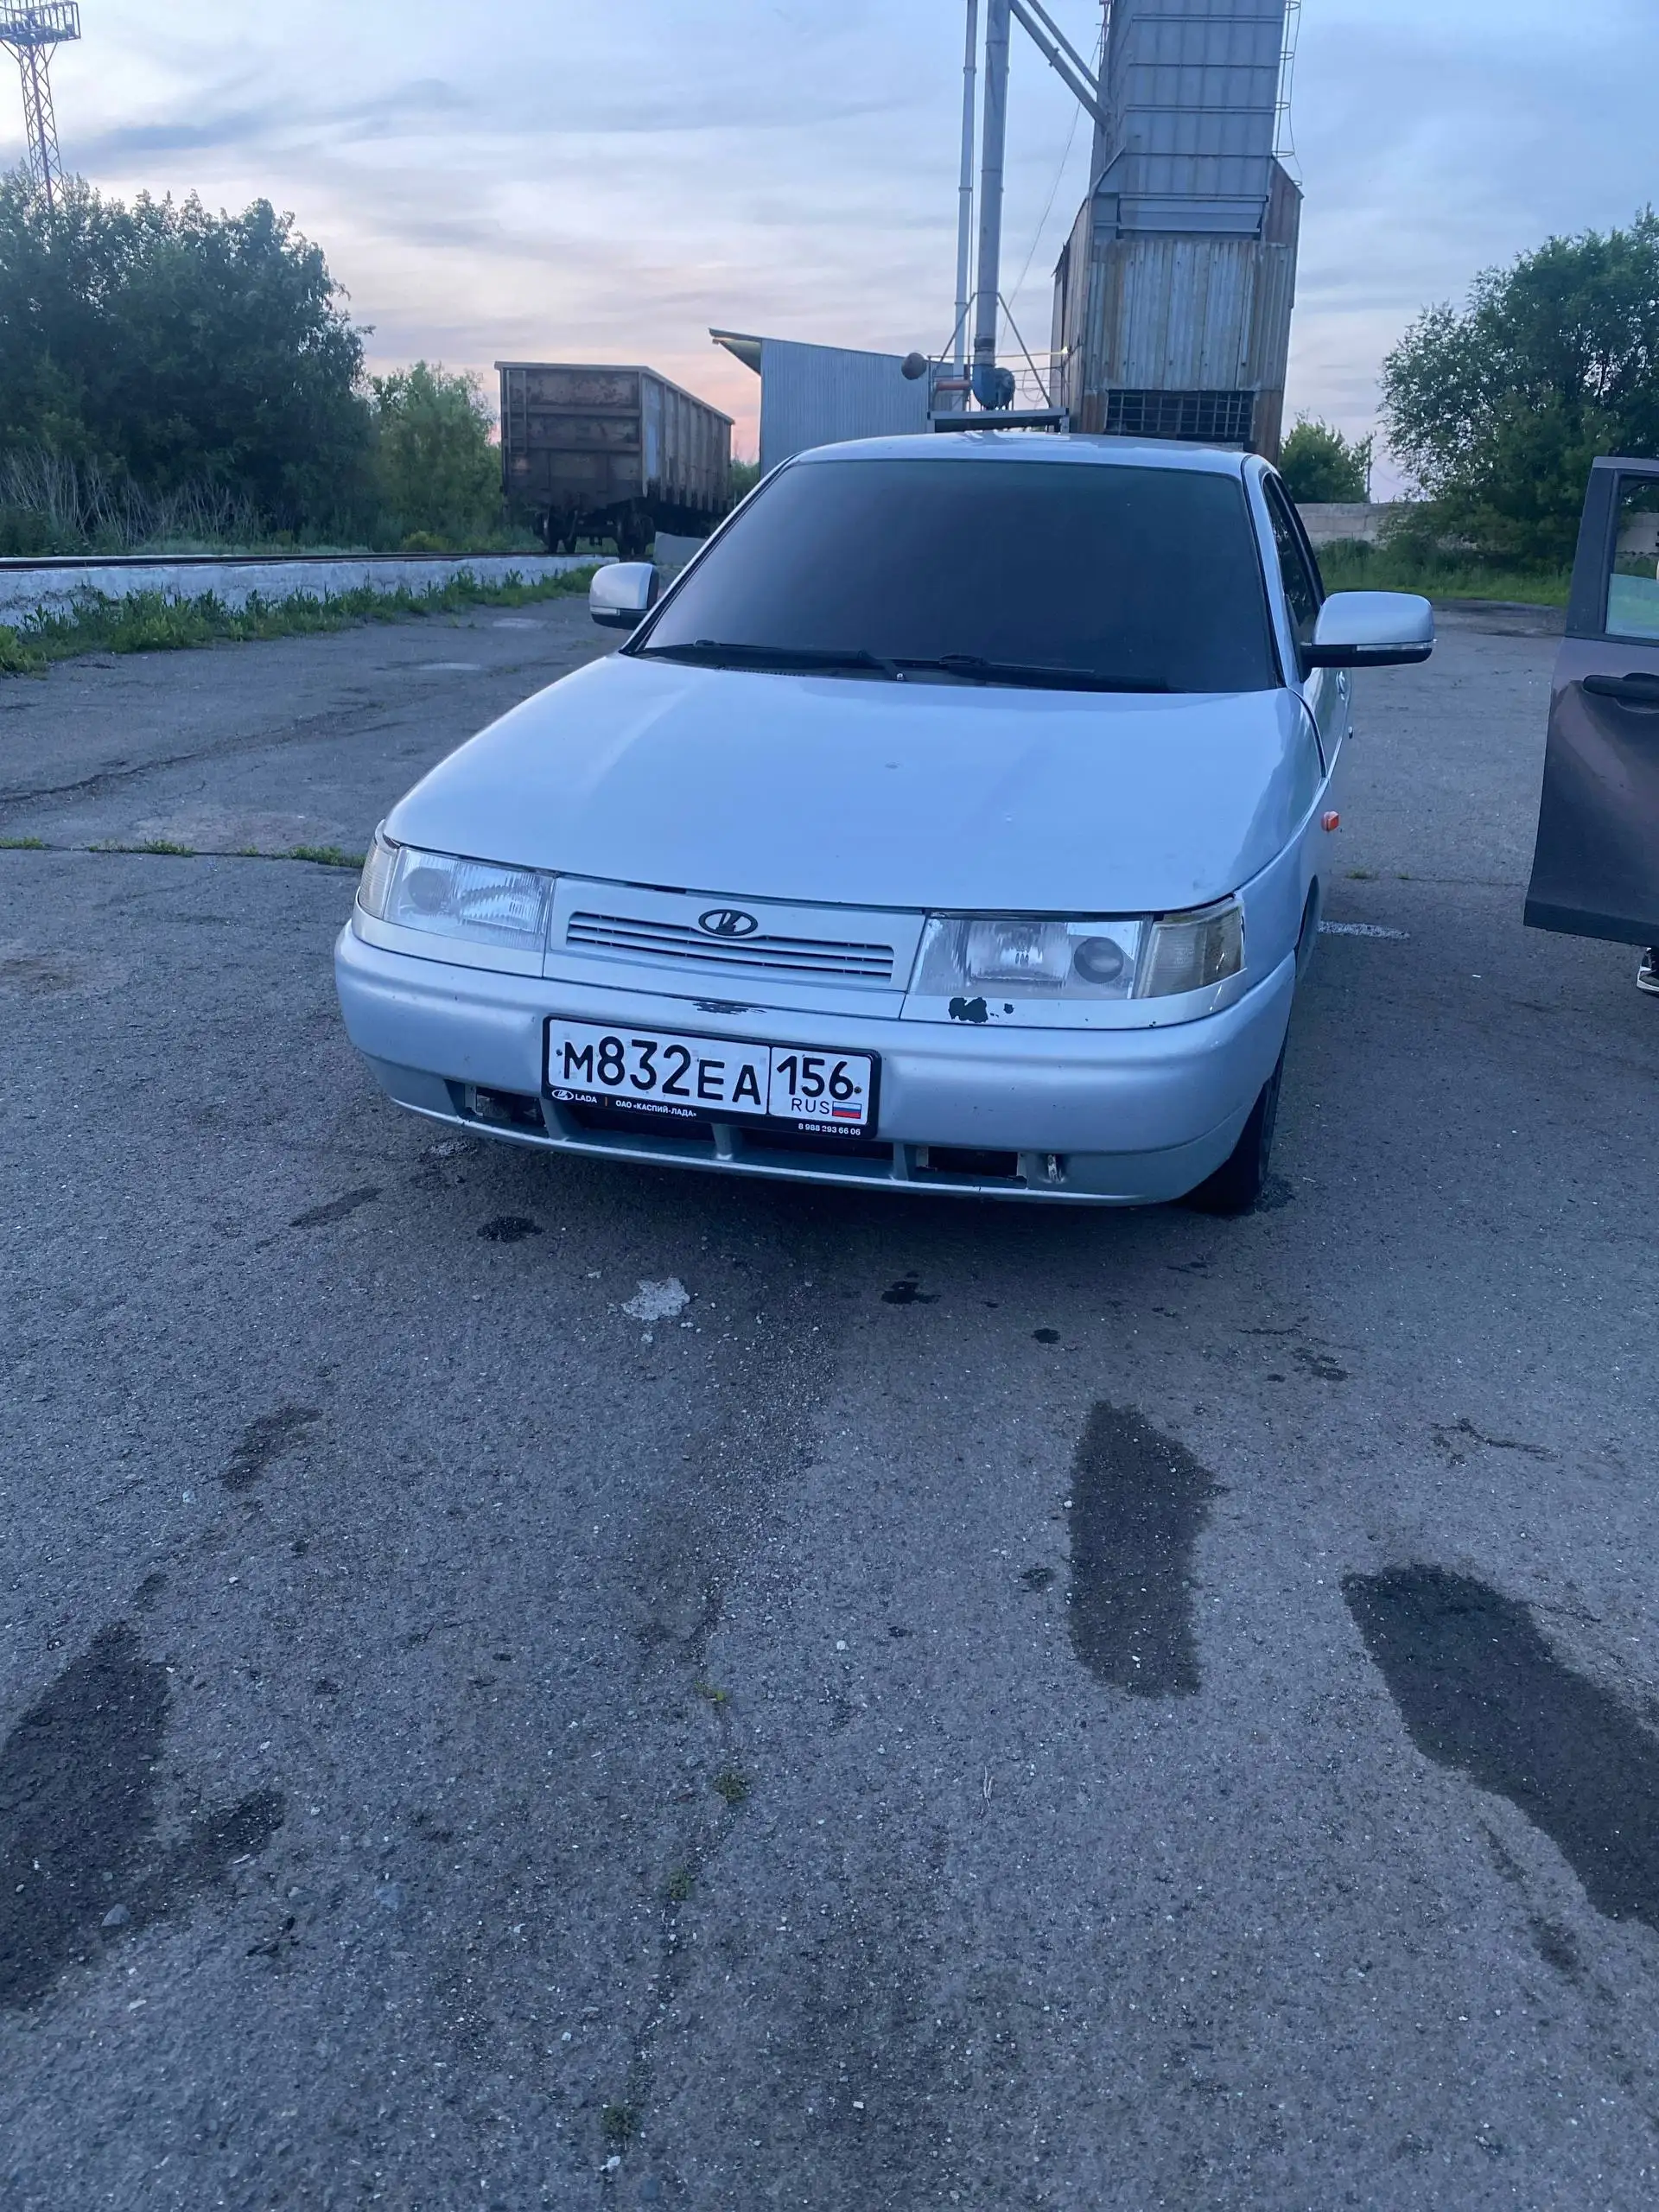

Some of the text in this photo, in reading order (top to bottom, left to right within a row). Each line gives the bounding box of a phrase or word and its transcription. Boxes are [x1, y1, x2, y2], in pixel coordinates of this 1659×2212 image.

[776, 1055, 854, 1101] 156
[575, 1093, 598, 1103] LADA
[791, 1097, 830, 1115] RUS
[615, 1100, 697, 1117] ОАО «КАСПИЙ-ЛАДА»
